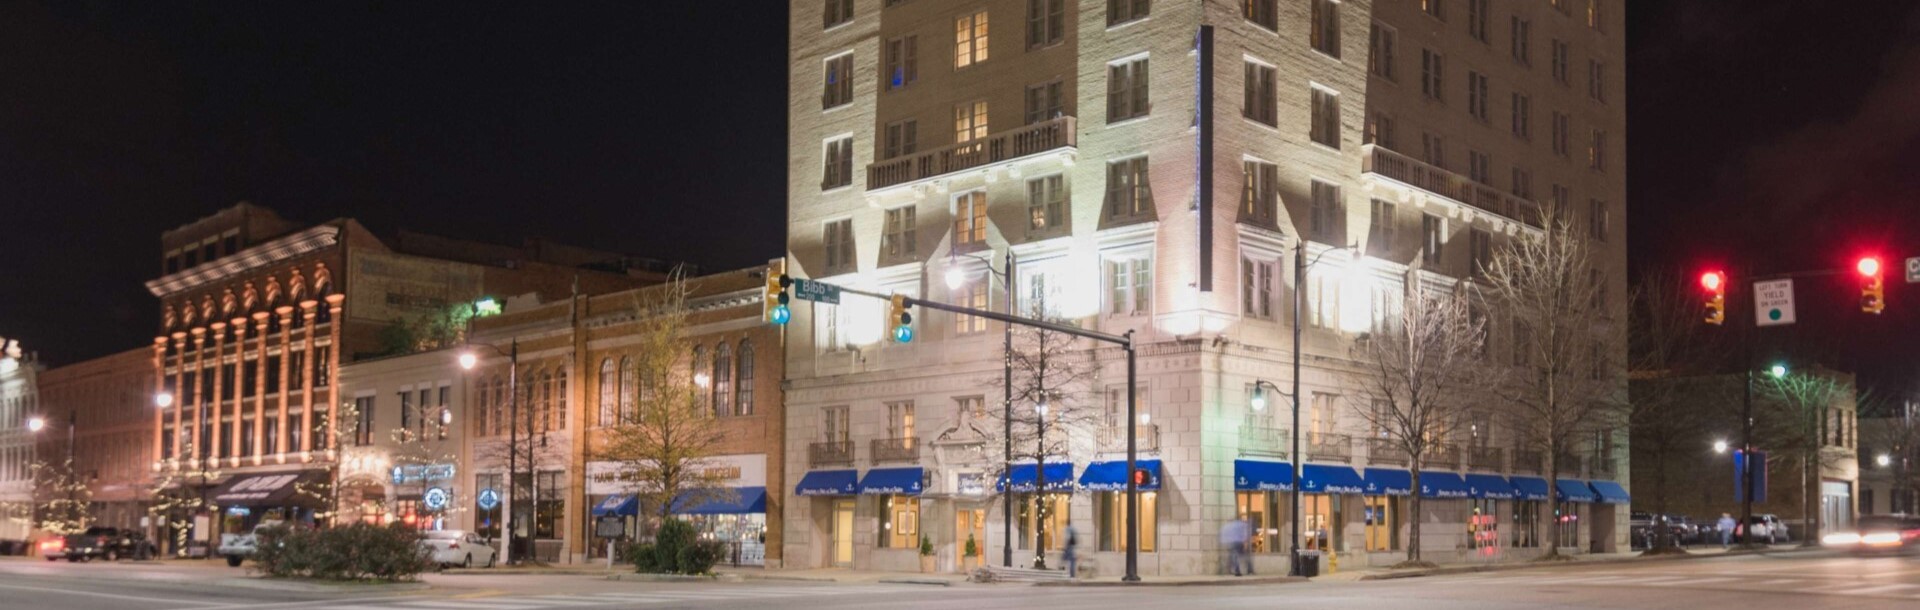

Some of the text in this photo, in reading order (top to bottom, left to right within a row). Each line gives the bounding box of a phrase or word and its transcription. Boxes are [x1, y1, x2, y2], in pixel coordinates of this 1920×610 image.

[803, 280, 826, 295] Bibb
[1763, 291, 1785, 299] YIELD
[594, 471, 615, 484] HANK
[703, 466, 741, 481] MUSEUM
